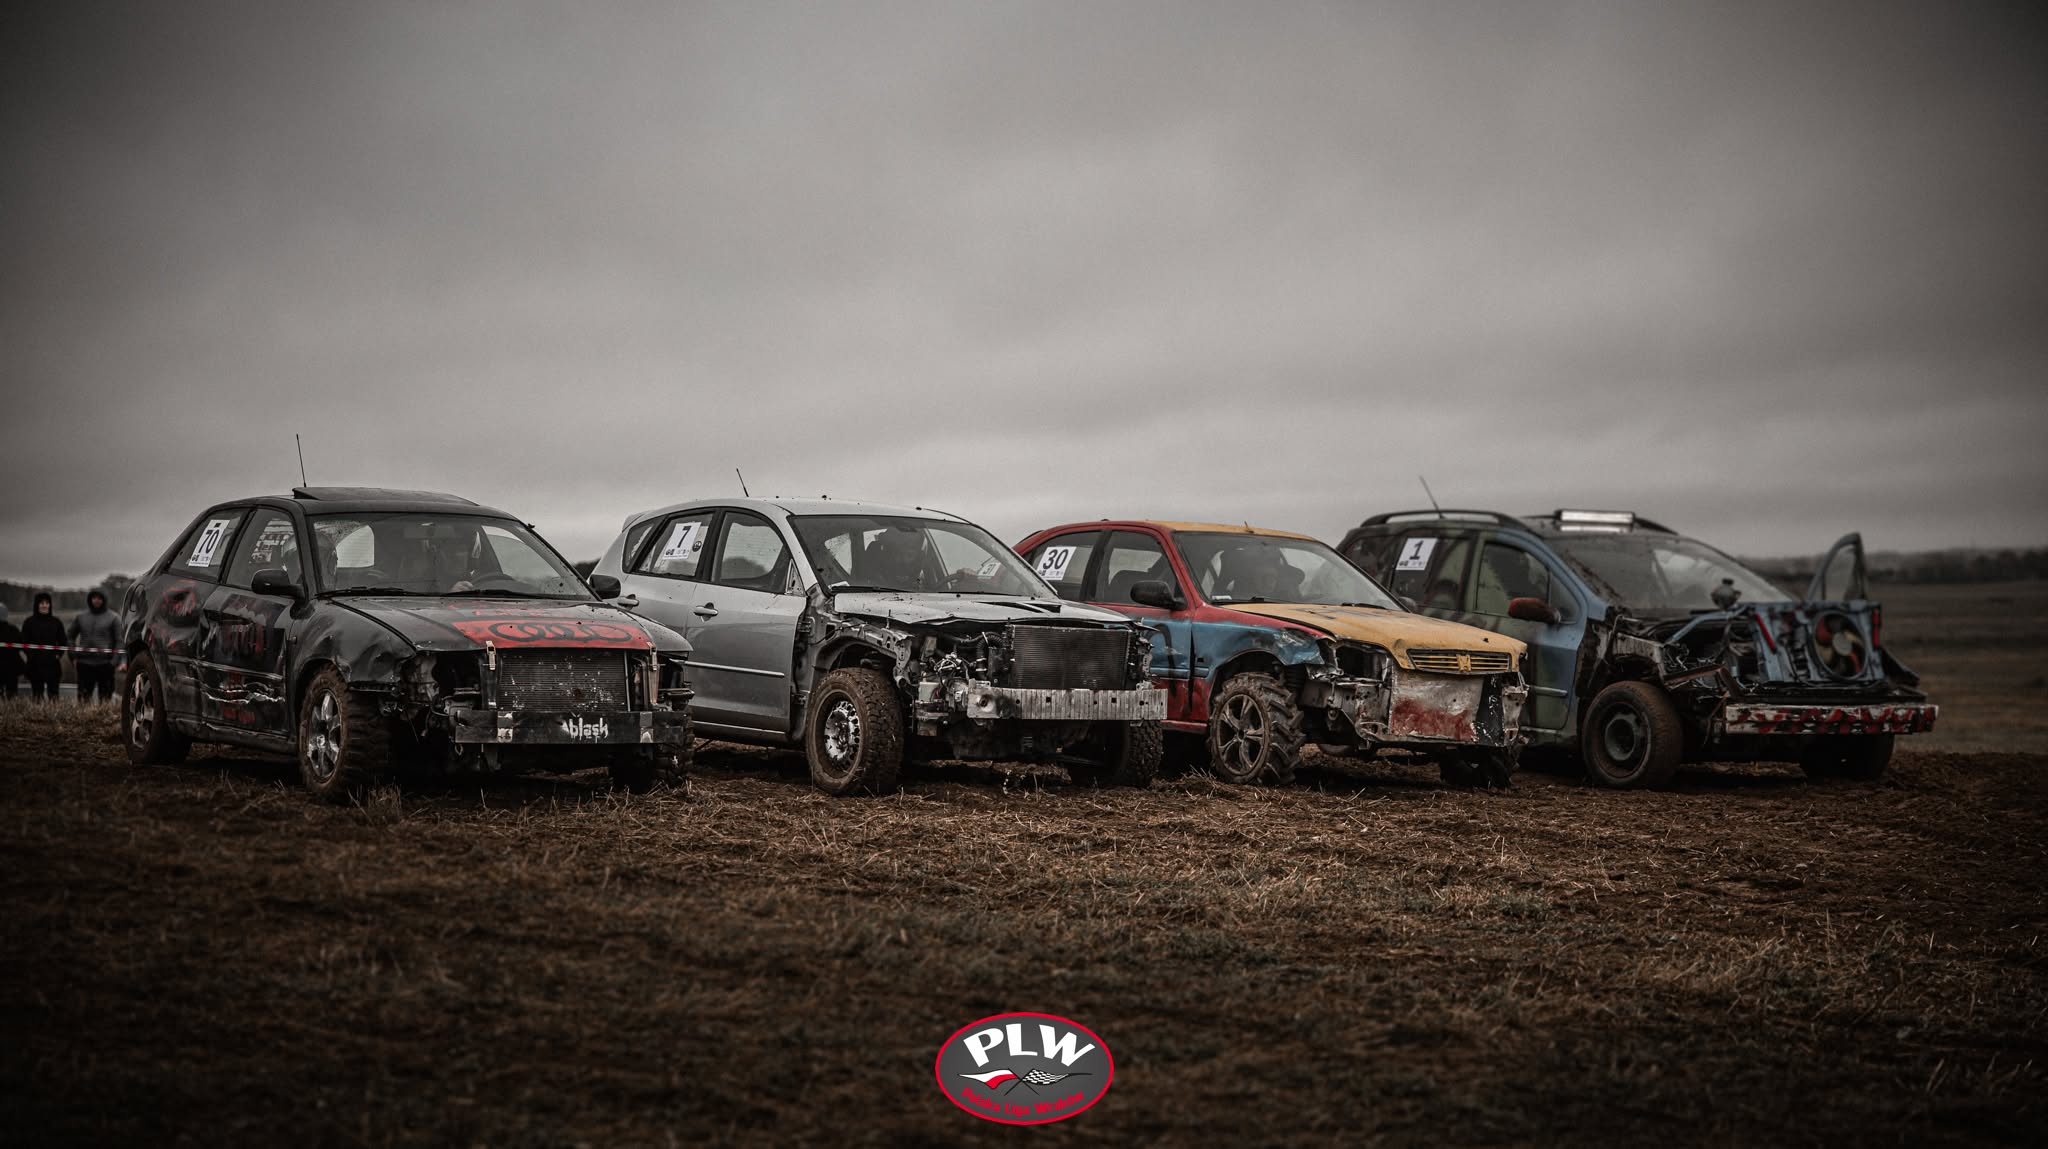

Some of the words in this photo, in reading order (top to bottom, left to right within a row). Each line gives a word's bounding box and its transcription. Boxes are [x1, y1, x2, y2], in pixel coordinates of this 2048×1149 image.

[198, 529, 219, 554] 70
[677, 525, 692, 548] 7
[1042, 549, 1069, 570] 30
[1409, 540, 1424, 560] 1
